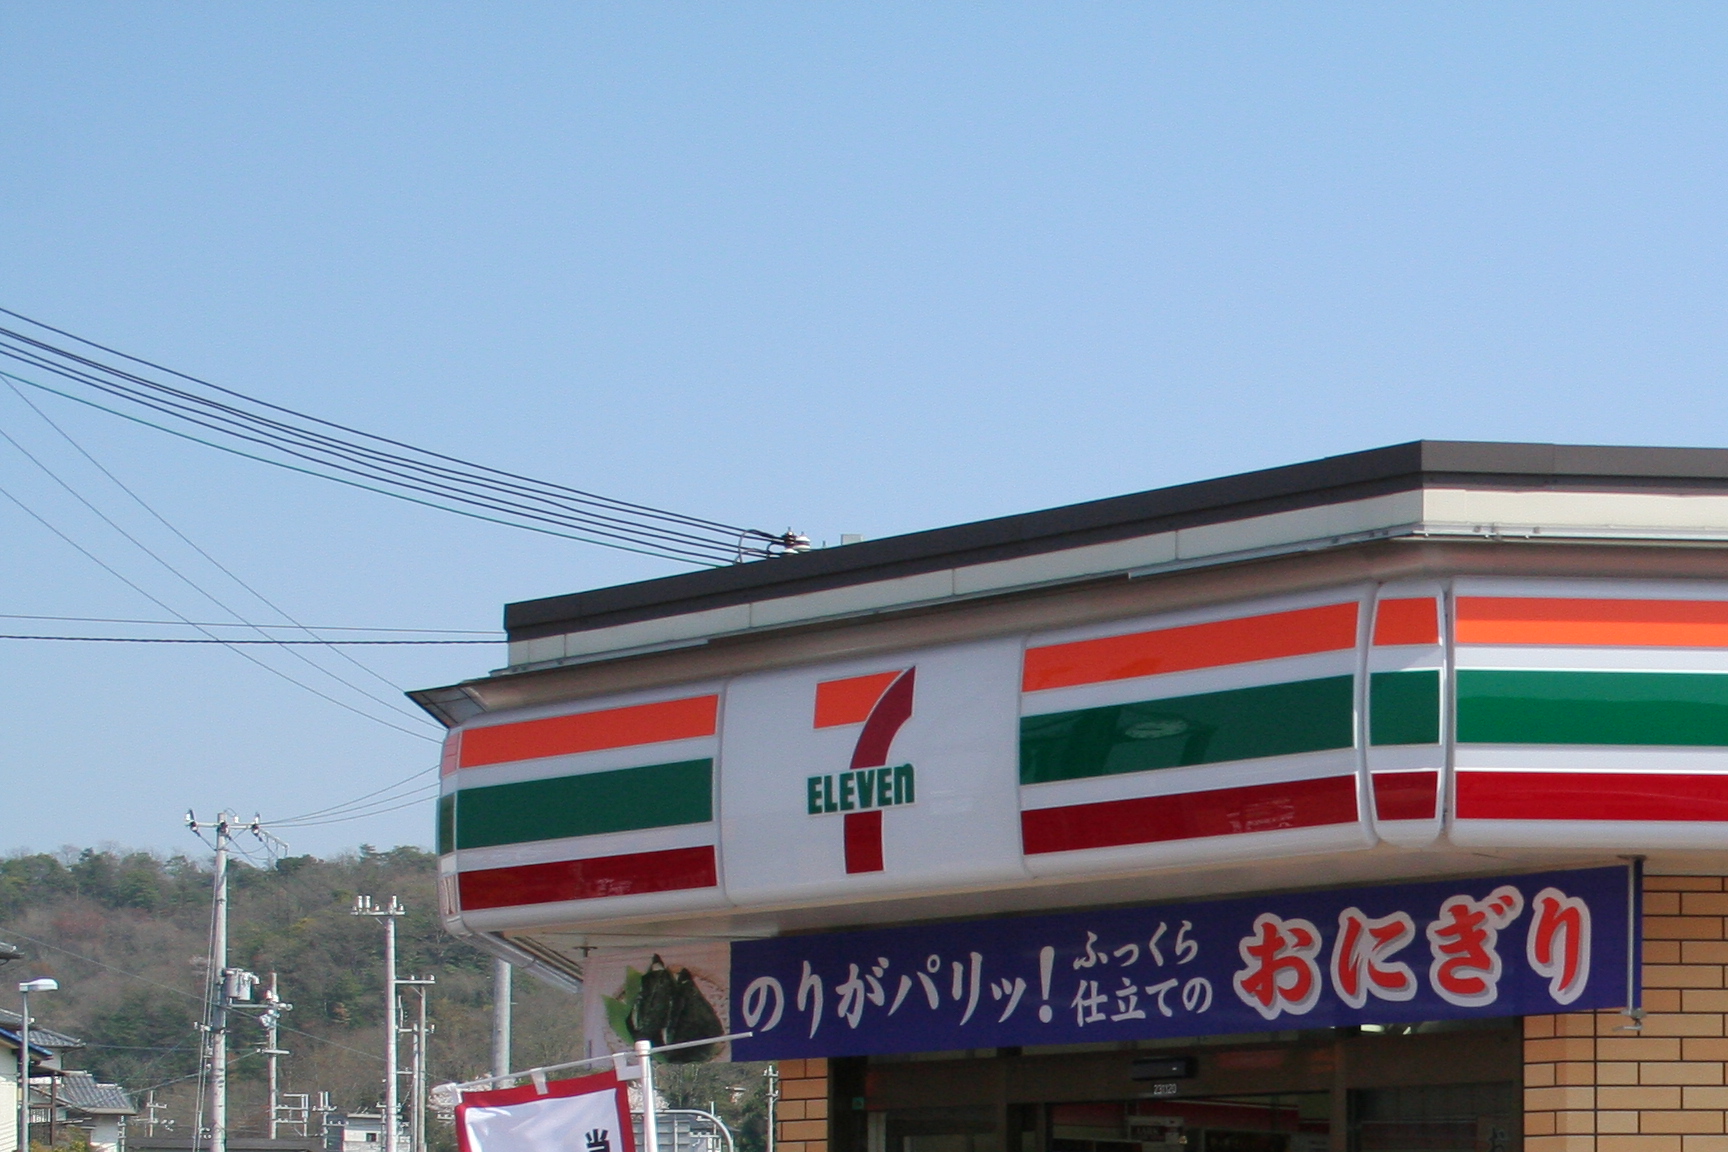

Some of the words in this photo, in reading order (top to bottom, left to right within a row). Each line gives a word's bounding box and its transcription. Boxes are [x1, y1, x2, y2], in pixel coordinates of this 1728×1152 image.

[1073, 921, 1200, 969] ふっくら
[1234, 885, 1594, 1020] おにぎり
[1070, 975, 1213, 1028] 仕立ての
